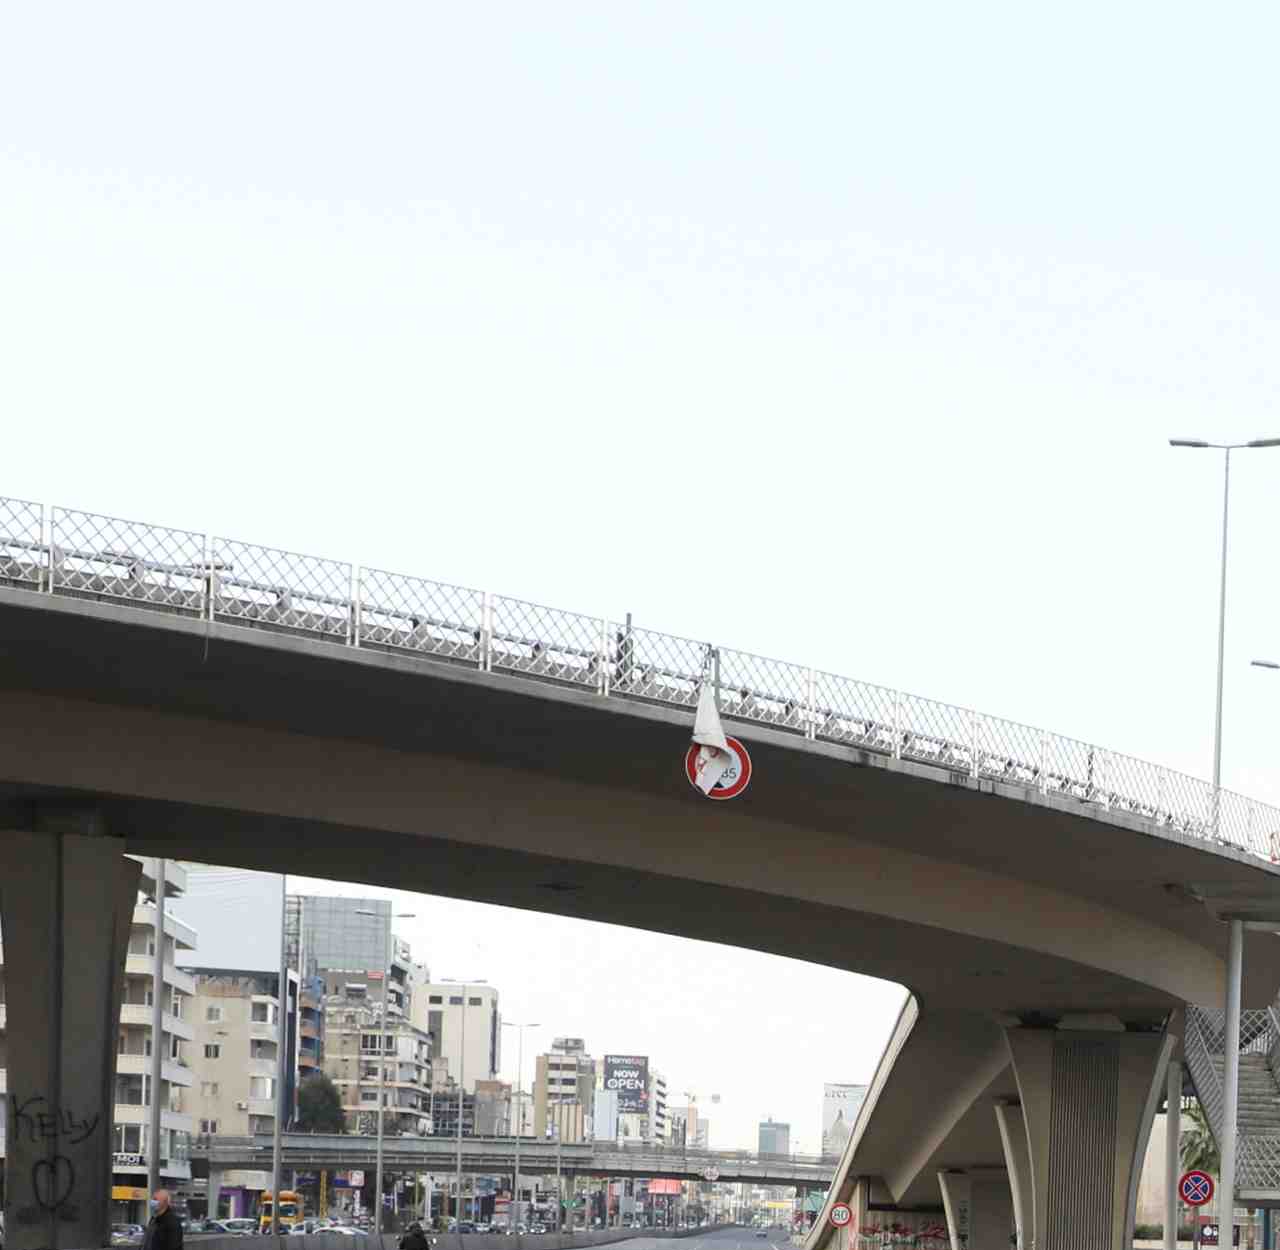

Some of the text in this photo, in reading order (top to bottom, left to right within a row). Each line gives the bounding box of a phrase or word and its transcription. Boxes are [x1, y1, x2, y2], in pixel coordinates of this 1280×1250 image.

[613, 1070, 640, 1078] NOW
[607, 1078, 645, 1089] OPEN
[832, 1209, 847, 1222] 80
